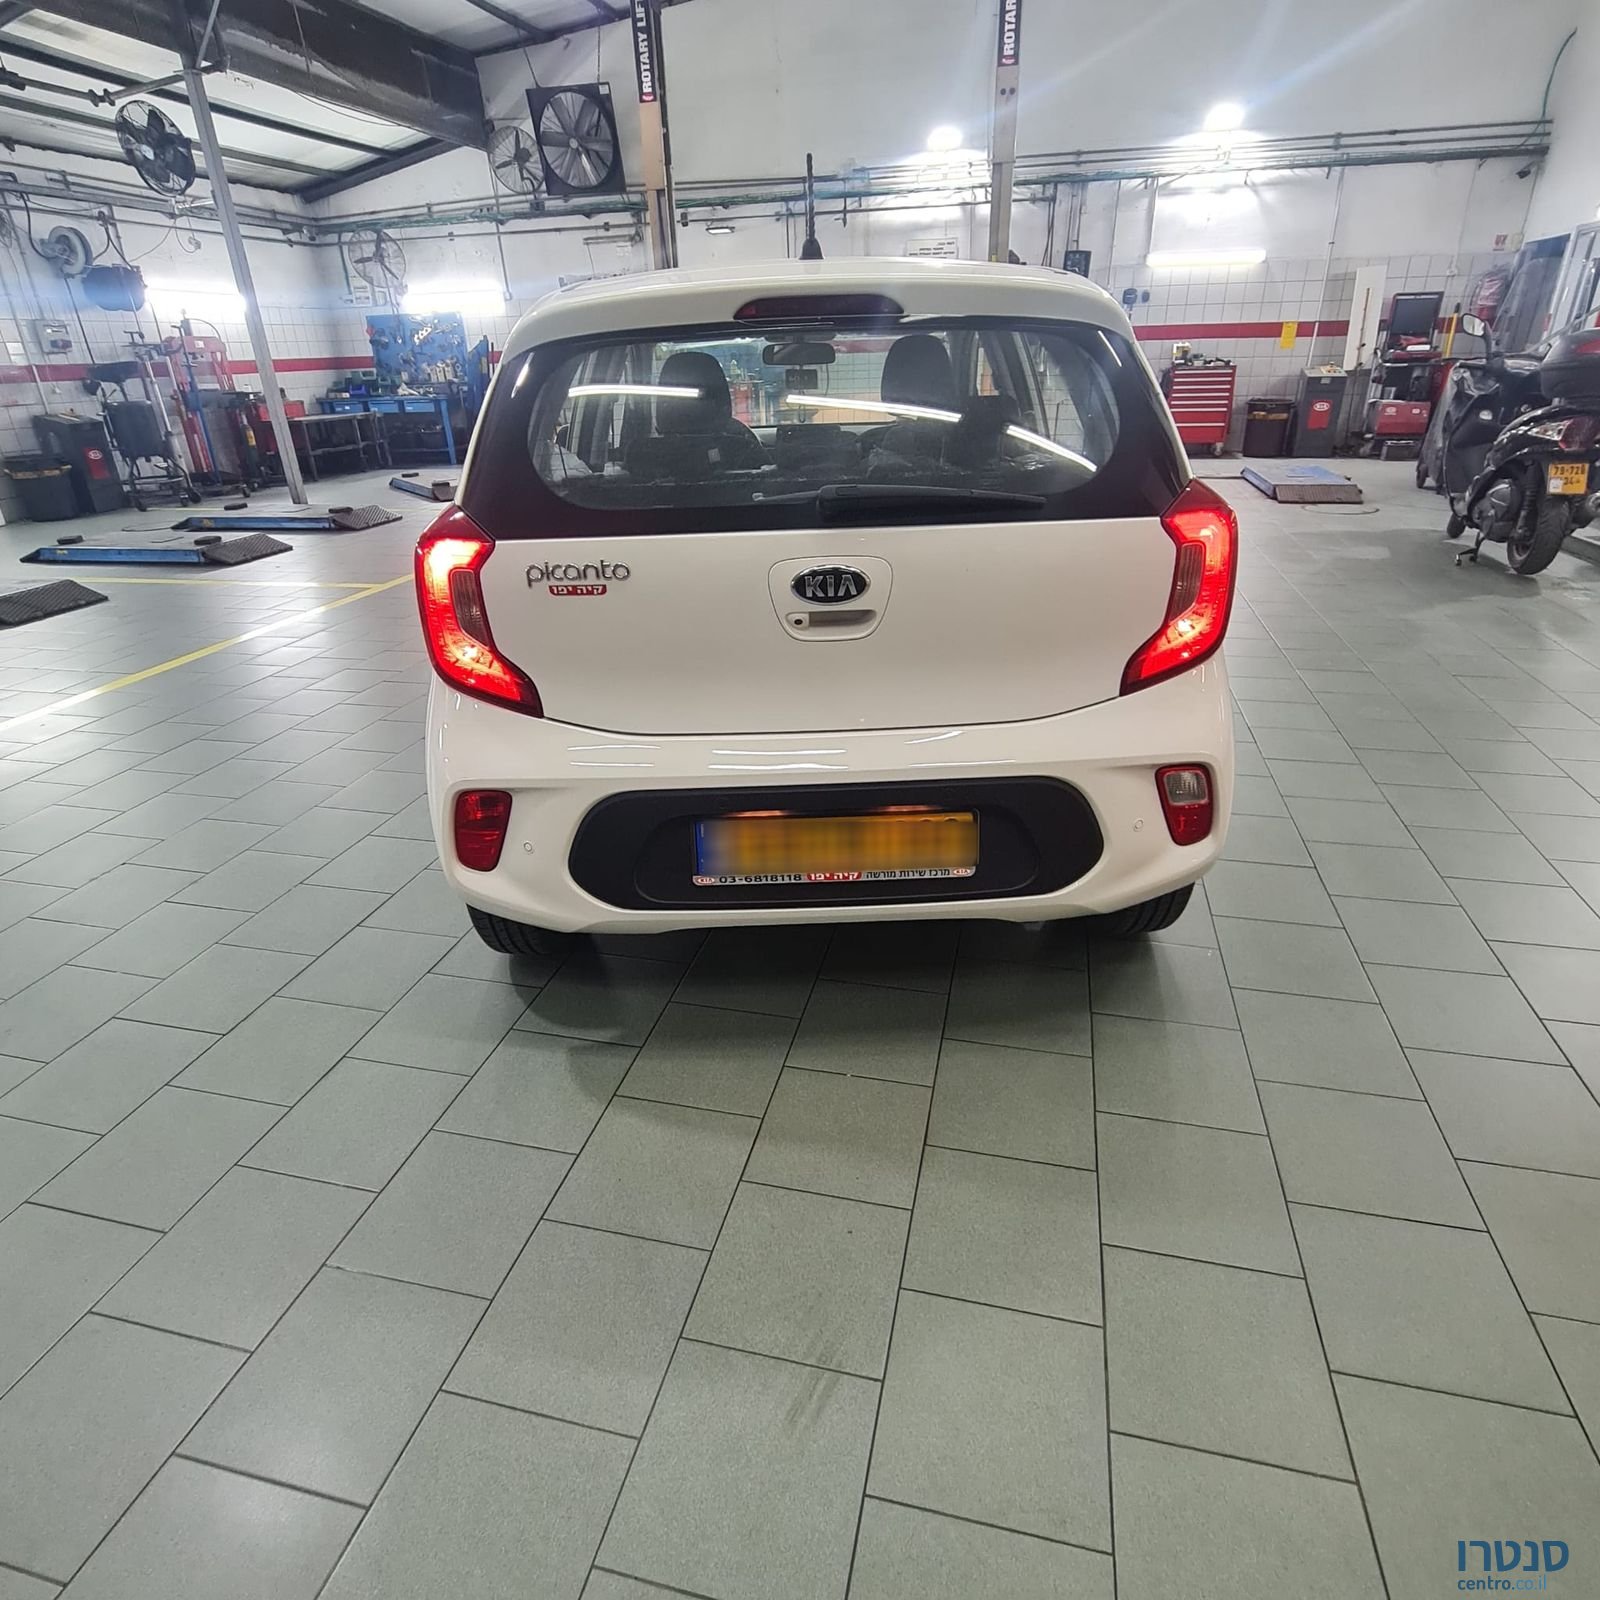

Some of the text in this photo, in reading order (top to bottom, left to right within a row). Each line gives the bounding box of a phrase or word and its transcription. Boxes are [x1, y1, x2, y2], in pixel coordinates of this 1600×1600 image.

[637, 32, 653, 93] ROTARY
[525, 560, 630, 588] picanto
[804, 574, 858, 597] KIA
[551, 585, 604, 595] קיה יפו
[719, 868, 950, 884] מרכז שירות מורשה קיה יפו 03-6818118
